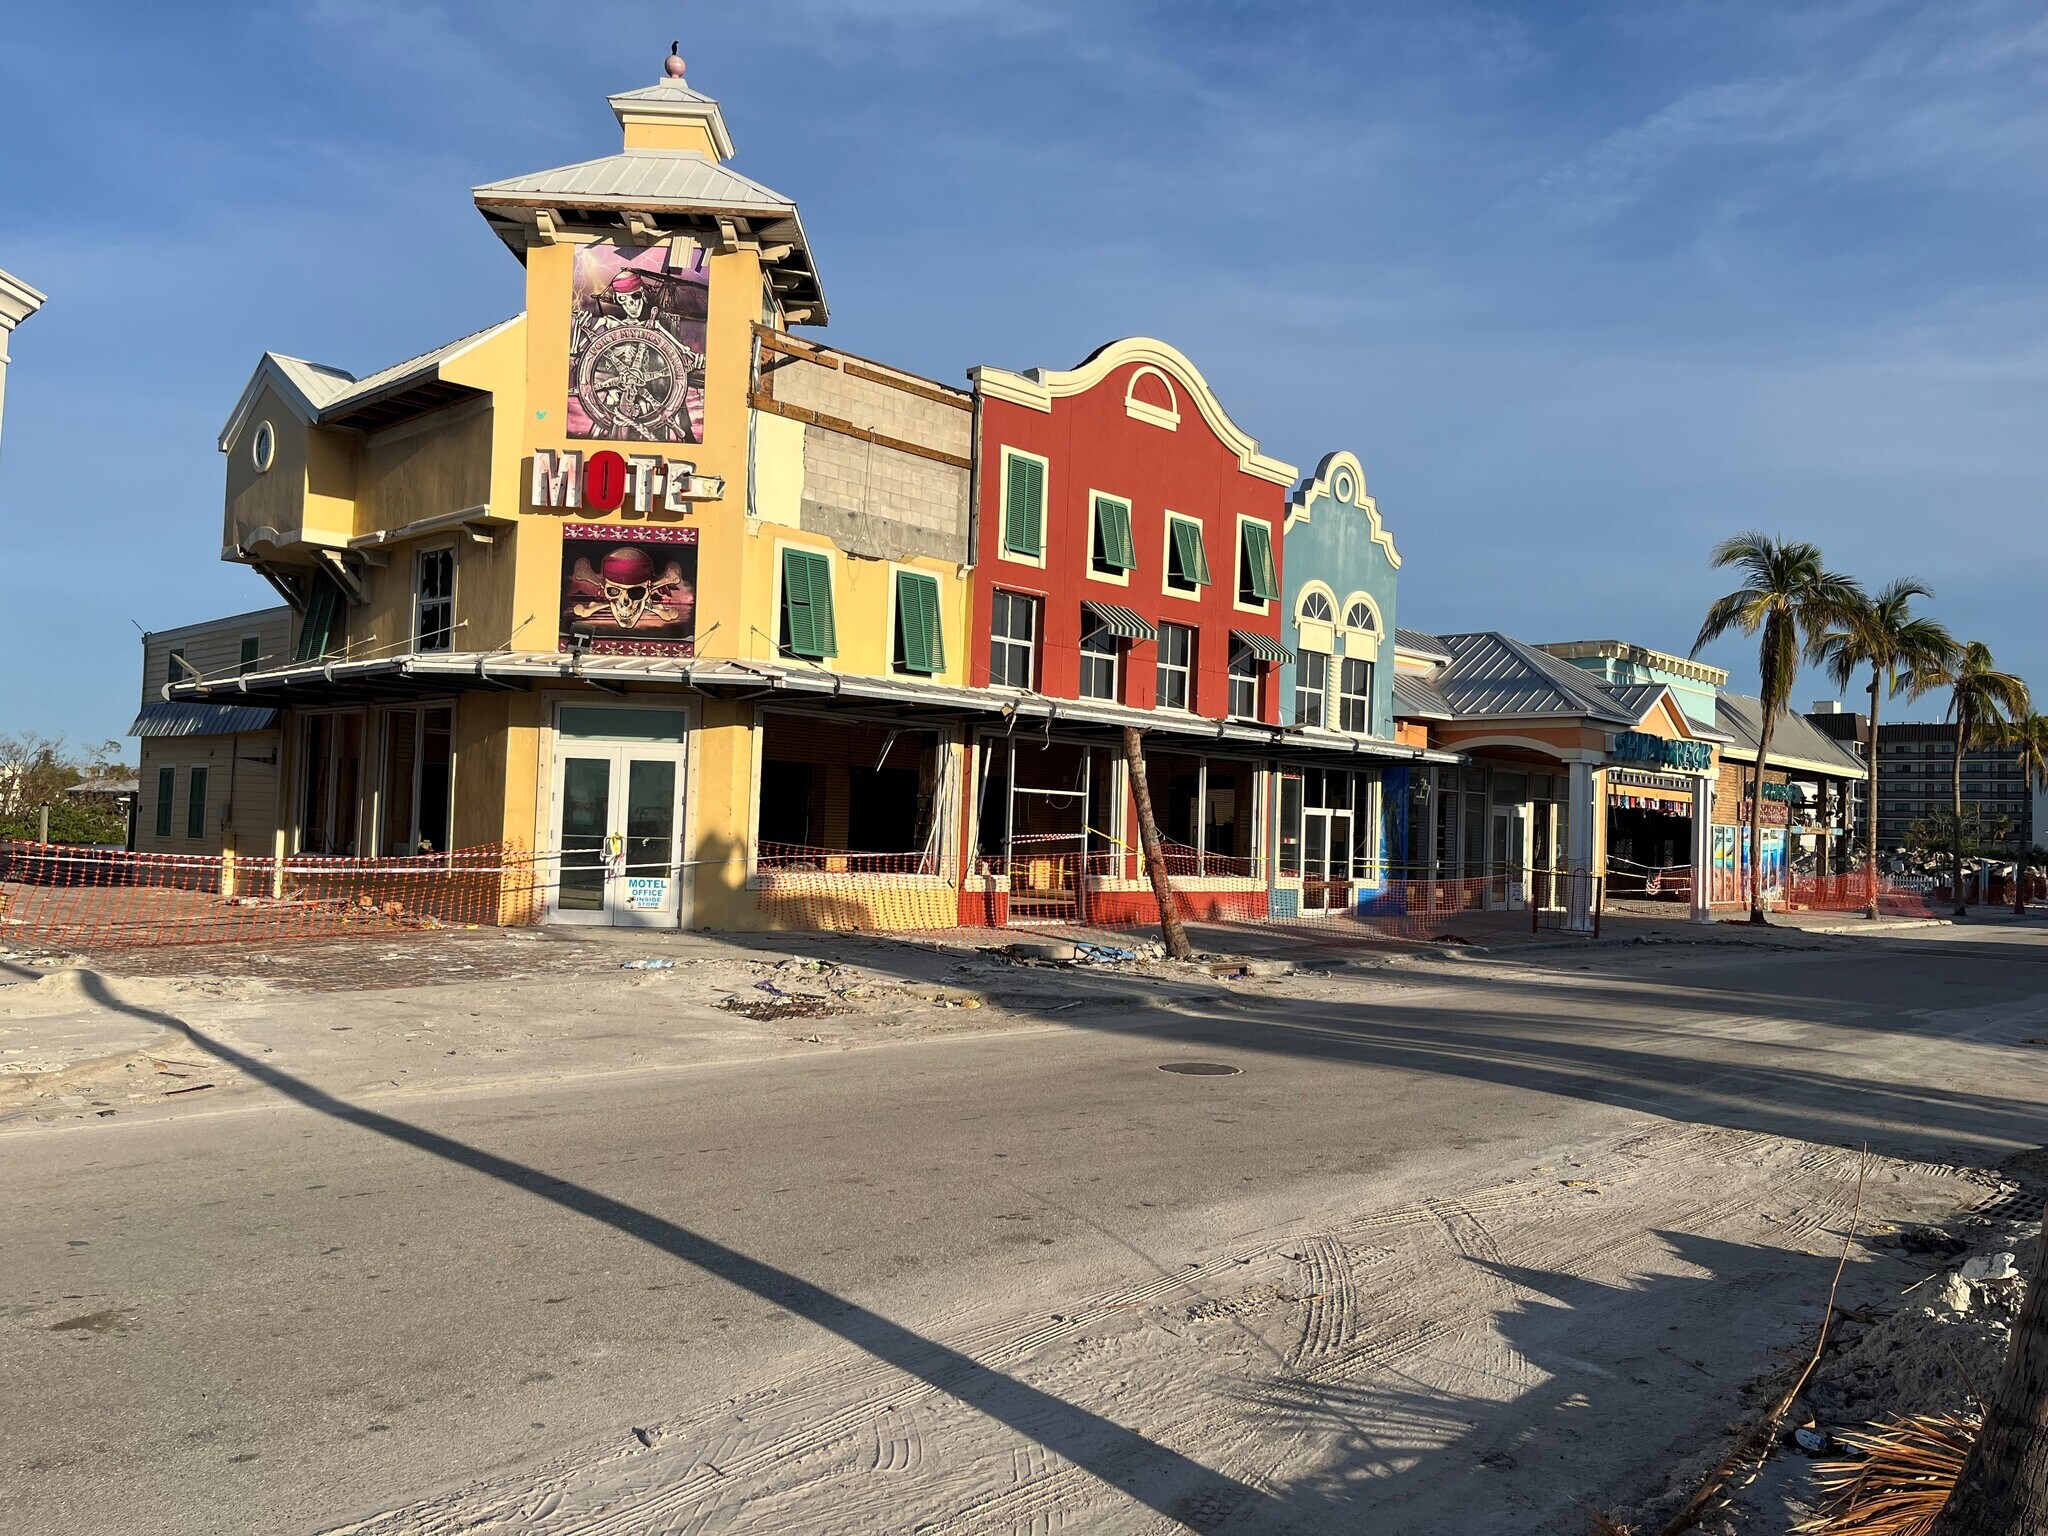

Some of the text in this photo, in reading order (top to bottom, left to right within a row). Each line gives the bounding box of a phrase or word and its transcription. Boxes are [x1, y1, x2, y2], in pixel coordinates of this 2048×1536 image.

[589, 328, 685, 380] FORT MYERS BEACH
[629, 879, 667, 889] MOTEL
[632, 889, 663, 897] OFFICE
